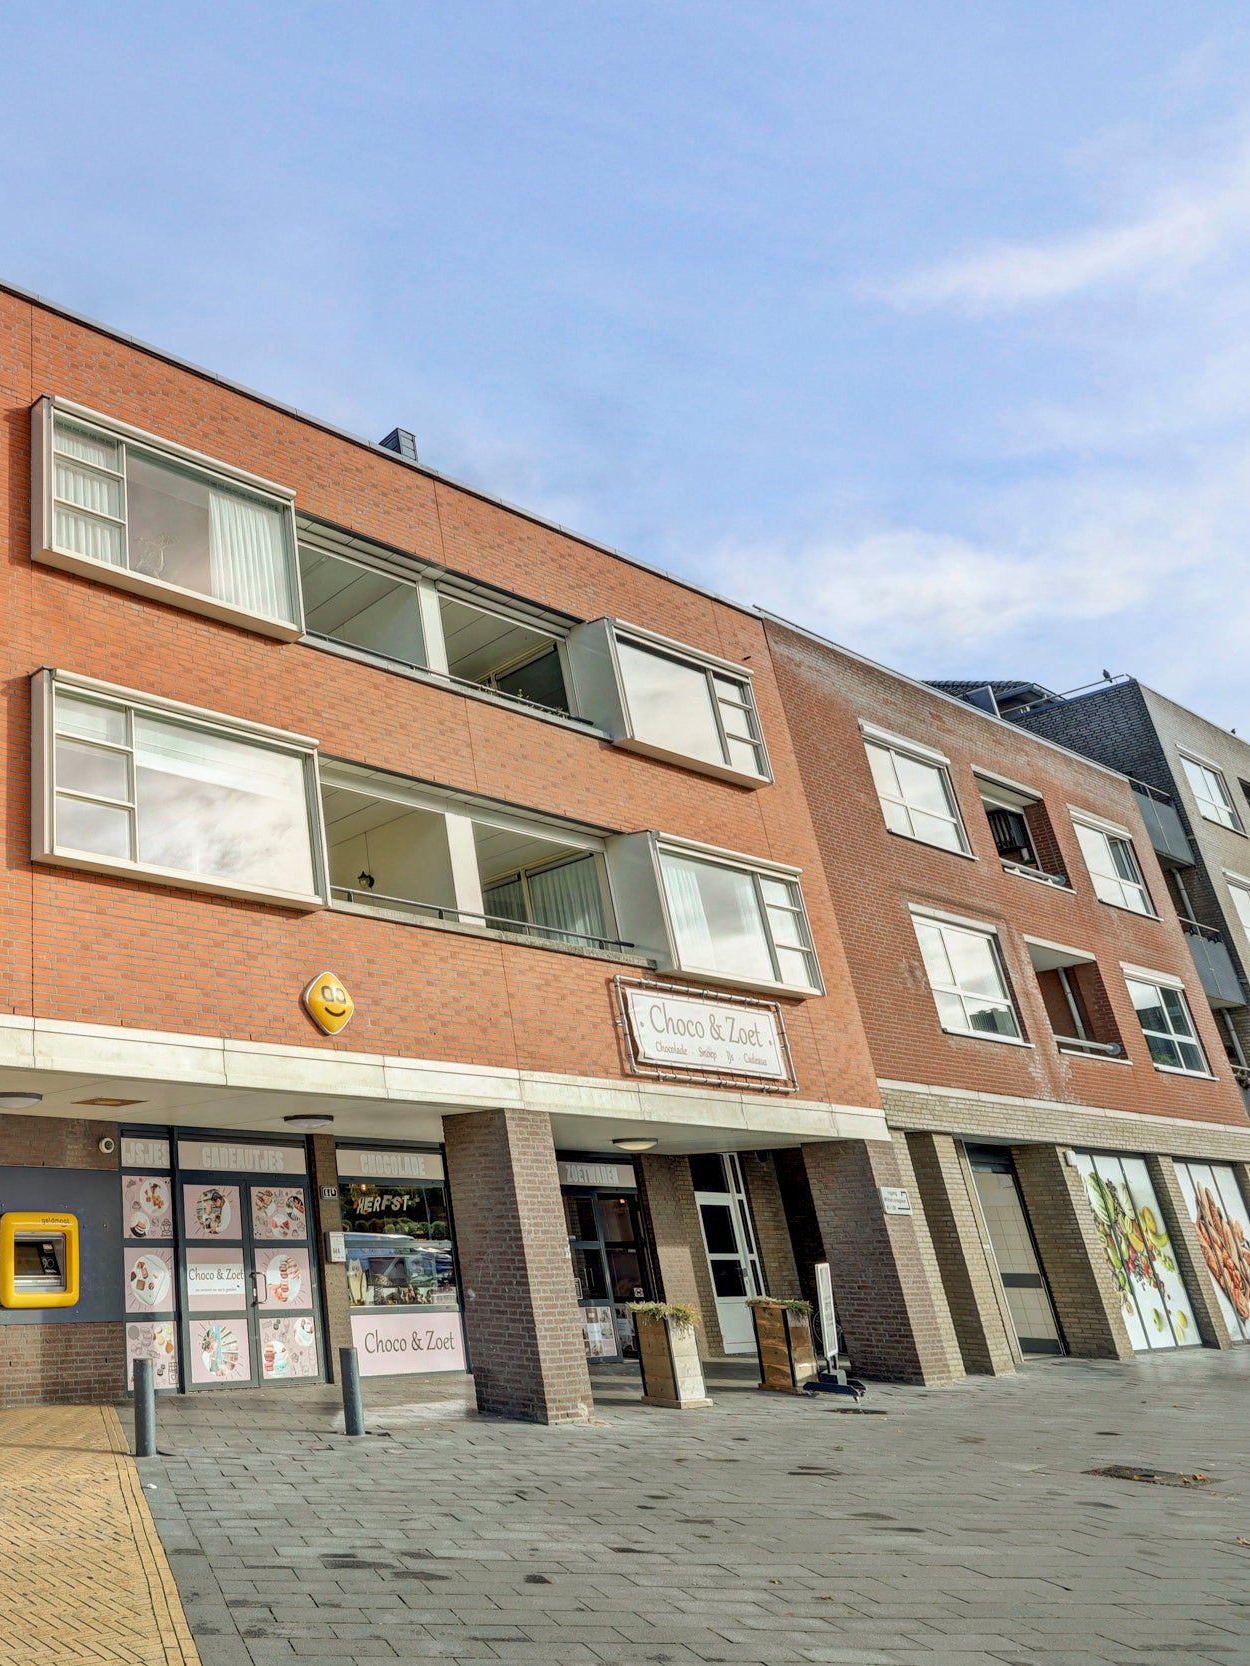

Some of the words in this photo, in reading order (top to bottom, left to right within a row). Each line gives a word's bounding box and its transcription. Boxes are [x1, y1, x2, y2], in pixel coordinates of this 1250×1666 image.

[649, 1002, 705, 1039] Choco
[709, 1013, 726, 1041] &
[725, 1016, 764, 1047] Zoet
[655, 1040, 688, 1056] Chocolade
[202, 1146, 285, 1172] CADEAUTJES
[360, 1153, 427, 1177] CHOCOLADE
[565, 1164, 619, 1185] ZOETWAREN
[356, 1194, 411, 1215] HERFST
[188, 1267, 215, 1281] Choco
[216, 1268, 224, 1280] &
[225, 1268, 244, 1280] Zoet
[364, 1329, 408, 1354] Choco
[411, 1330, 424, 1352] &
[425, 1330, 456, 1351] Zoet
